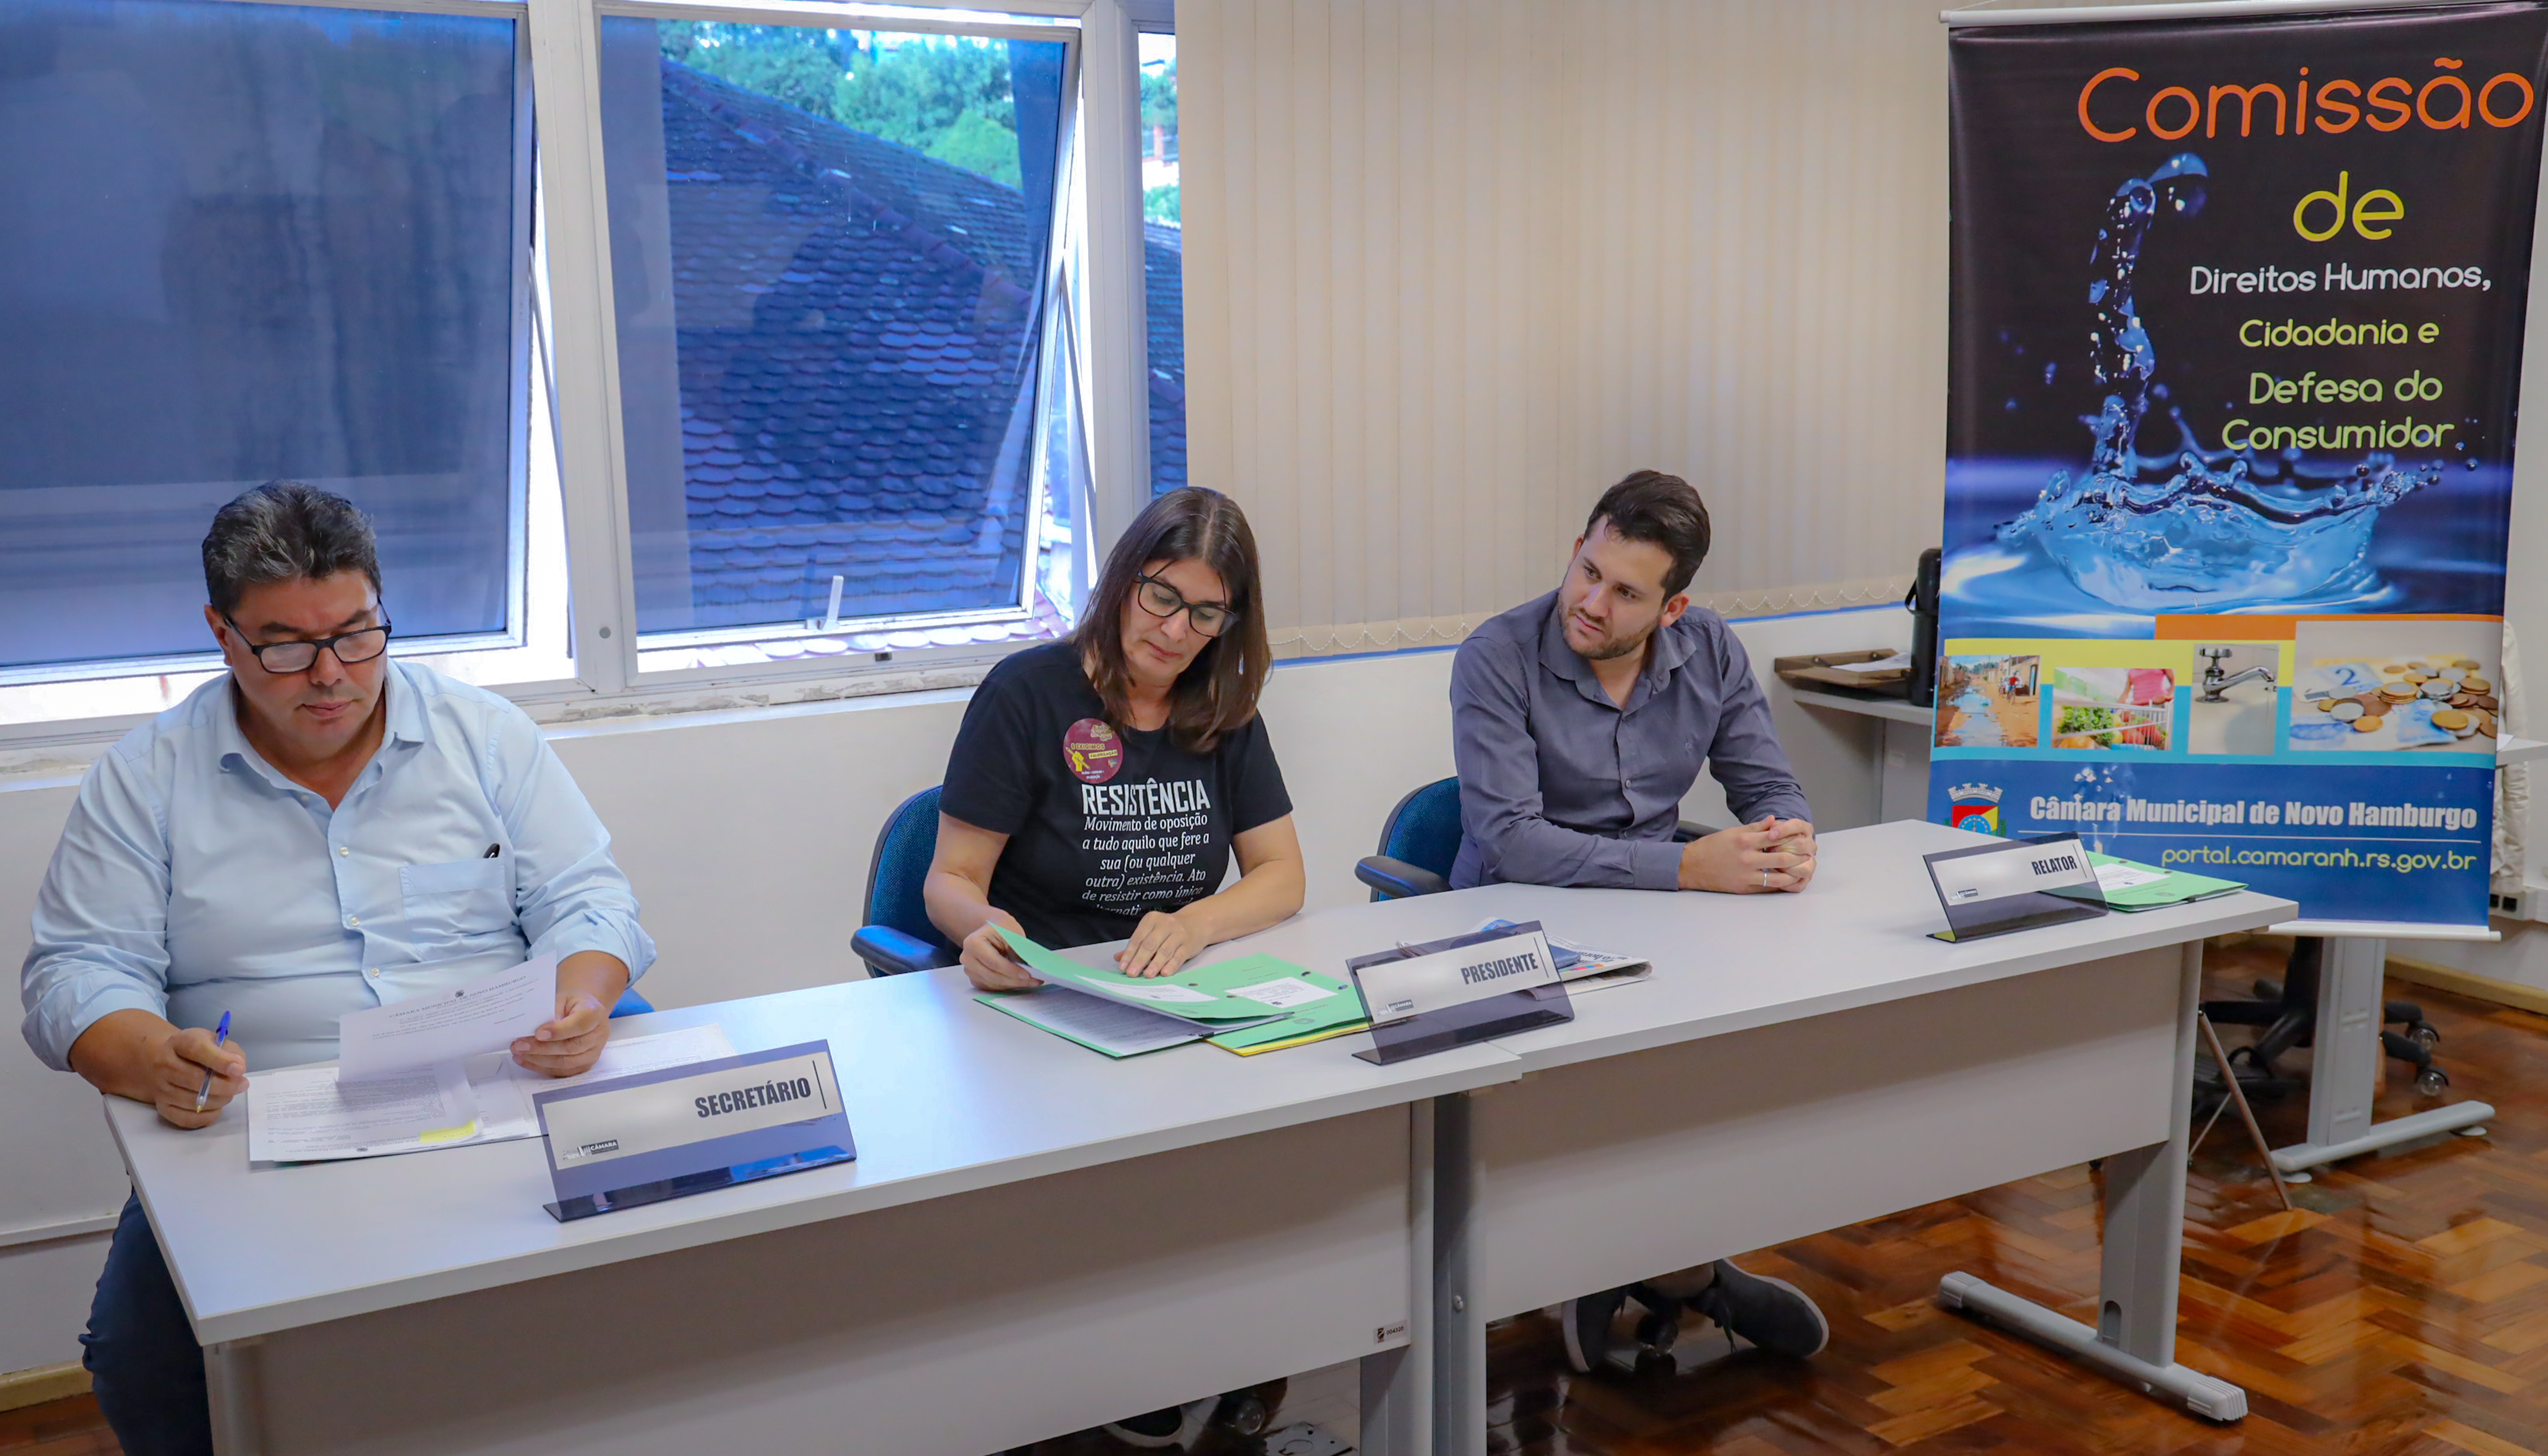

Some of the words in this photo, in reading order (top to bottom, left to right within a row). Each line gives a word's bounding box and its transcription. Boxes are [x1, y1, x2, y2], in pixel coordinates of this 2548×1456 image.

[2078, 57, 2534, 142] Comissão
[2294, 171, 2404, 241] de
[2190, 265, 2316, 294] Direitos
[2324, 263, 2492, 291] Humanos,
[2239, 318, 2408, 347] Cidadania
[2417, 322, 2439, 343] e
[2249, 372, 2383, 404] Defesa
[2394, 370, 2443, 401] do
[2222, 416, 2455, 450] Consumidor
[1081, 777, 1211, 816] RESISTÊNCIA
[1084, 816, 1142, 831] Movimento
[1144, 816, 1157, 830] de
[1160, 812, 1208, 832] oposição
[2030, 796, 2121, 822] Câmara
[2126, 798, 2245, 825] Municipal
[2249, 801, 2280, 825] de
[2285, 801, 2344, 826] Novo
[2349, 802, 2477, 830] Hamburgo
[1082, 839, 1090, 849] a
[1093, 836, 1119, 850] tudo
[1122, 835, 1155, 853] aquilo
[1159, 837, 1178, 852] que
[1180, 831, 1201, 849] fere
[1203, 833, 1209, 844] a
[1100, 859, 1121, 870] sua
[1124, 855, 1142, 873] (ou
[1146, 852, 1196, 871] qualquer
[2032, 855, 2077, 875] RELATOR
[2162, 845, 2477, 873] portal.camaranh.rs.gov.br
[1082, 890, 1097, 900] de
[1099, 890, 1142, 901] resistir
[1142, 891, 1173, 900] como
[1175, 885, 1204, 897] única
[1085, 874, 1125, 890] outra)
[1127, 872, 1184, 886] existência.
[1188, 868, 1206, 881] Ato
[1461, 953, 1538, 984] PRESIDENTE
[695, 1077, 811, 1118] SECRETÁRIO
[591, 1141, 617, 1150] CÂMARA
